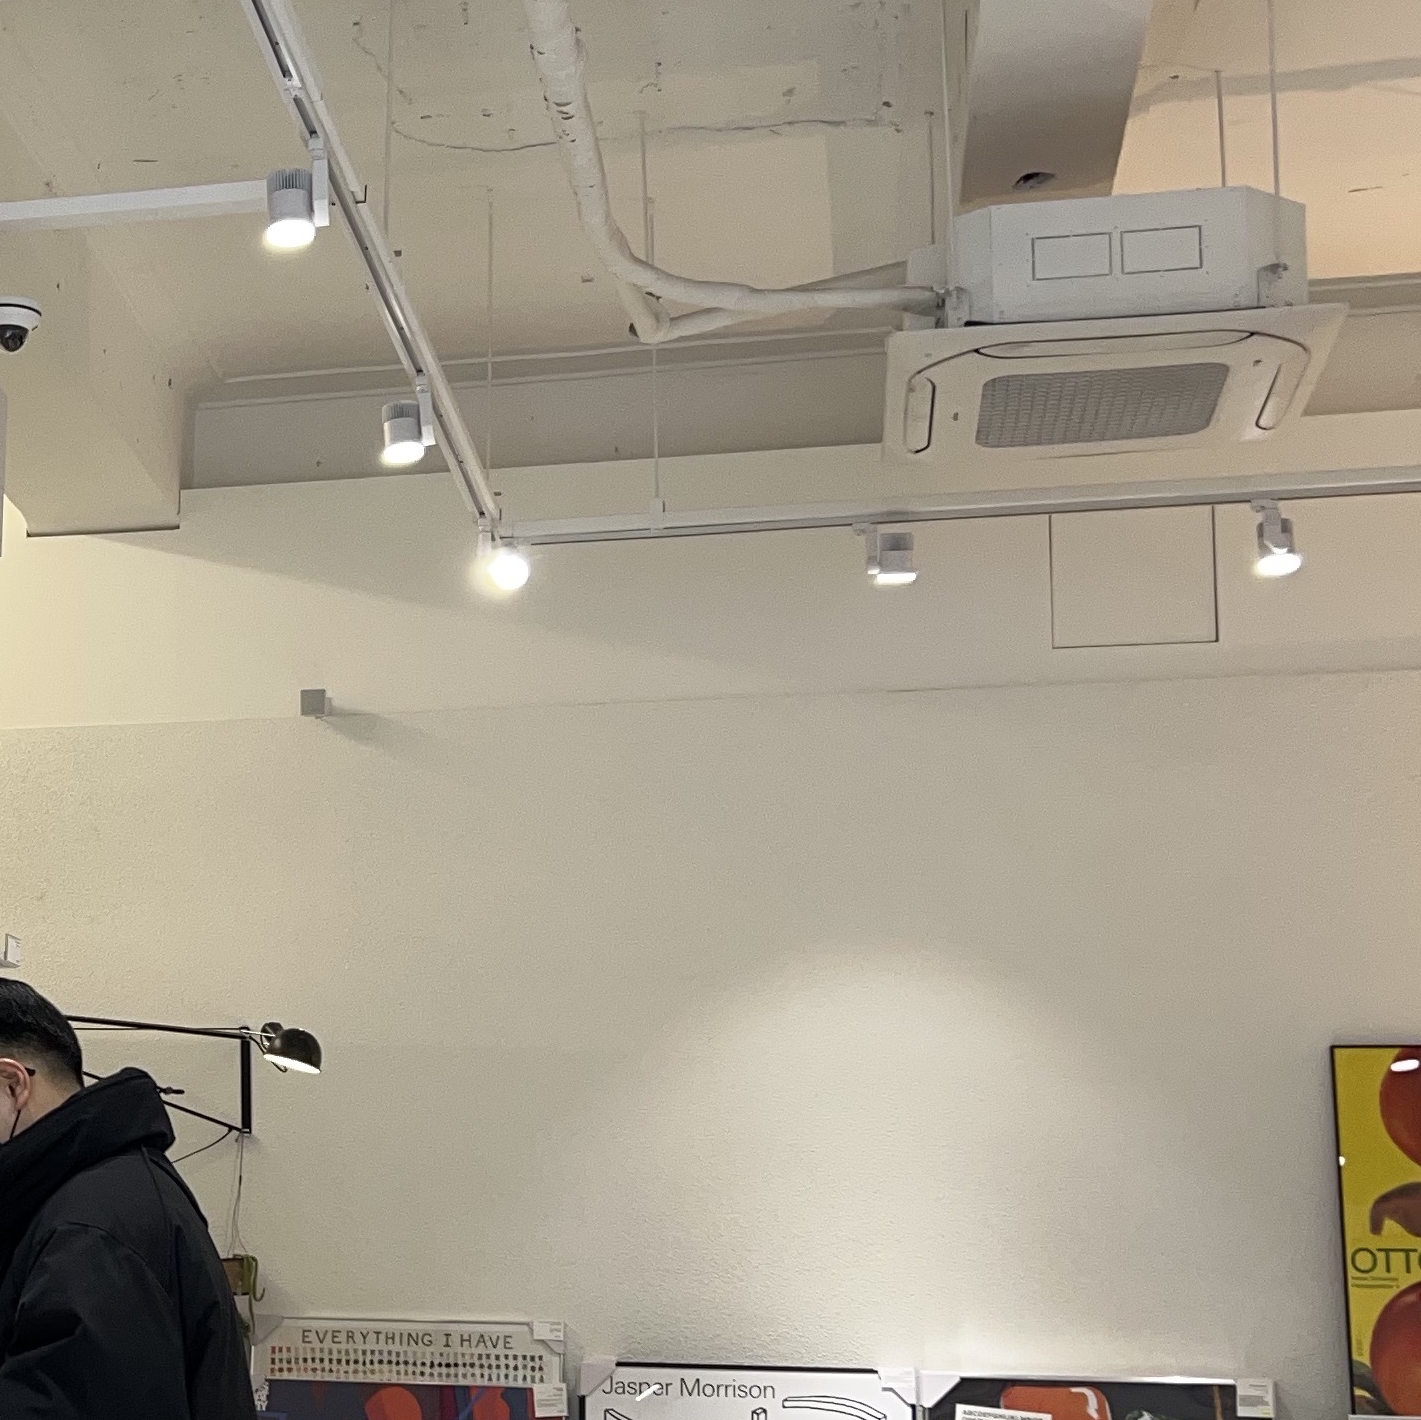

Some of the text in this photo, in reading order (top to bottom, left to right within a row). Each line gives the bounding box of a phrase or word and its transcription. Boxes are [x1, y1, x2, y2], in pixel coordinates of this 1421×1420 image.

[301, 1329, 514, 1350] EVERYTHING I HAVE
[680, 1377, 776, 1399] Morrison
